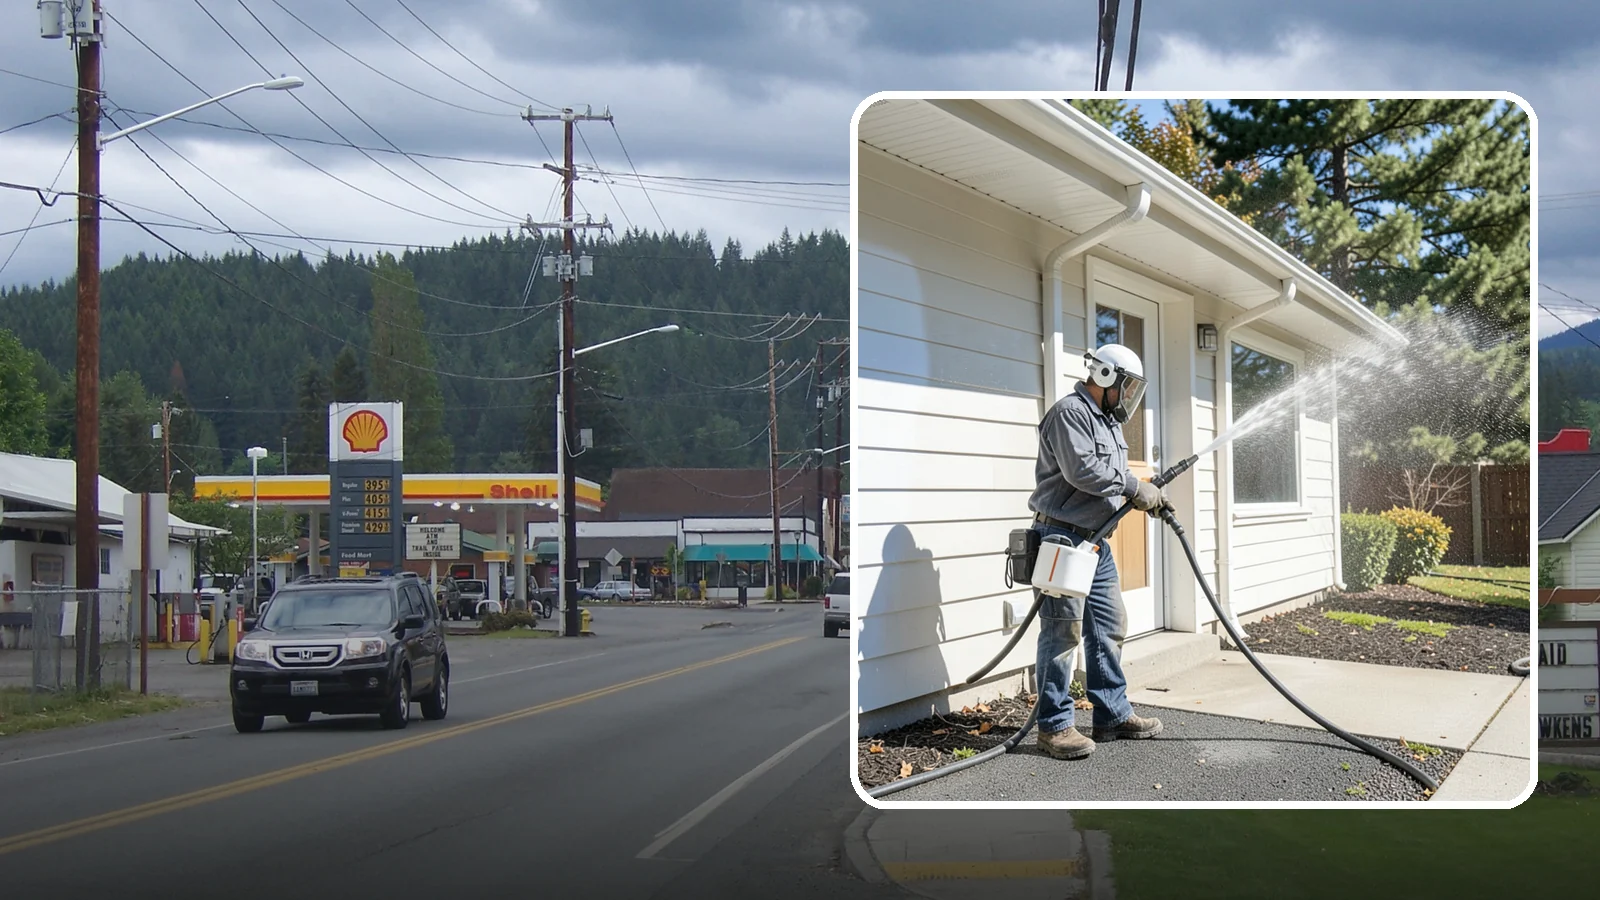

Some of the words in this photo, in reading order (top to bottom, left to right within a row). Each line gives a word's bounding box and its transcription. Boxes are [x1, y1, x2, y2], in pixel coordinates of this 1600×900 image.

[366, 480, 383, 490] 395
[490, 485, 547, 499] Shell
[366, 494, 383, 504] 405
[366, 508, 383, 518] 415
[366, 522, 383, 532] 429
[1539, 643, 1566, 665] AID
